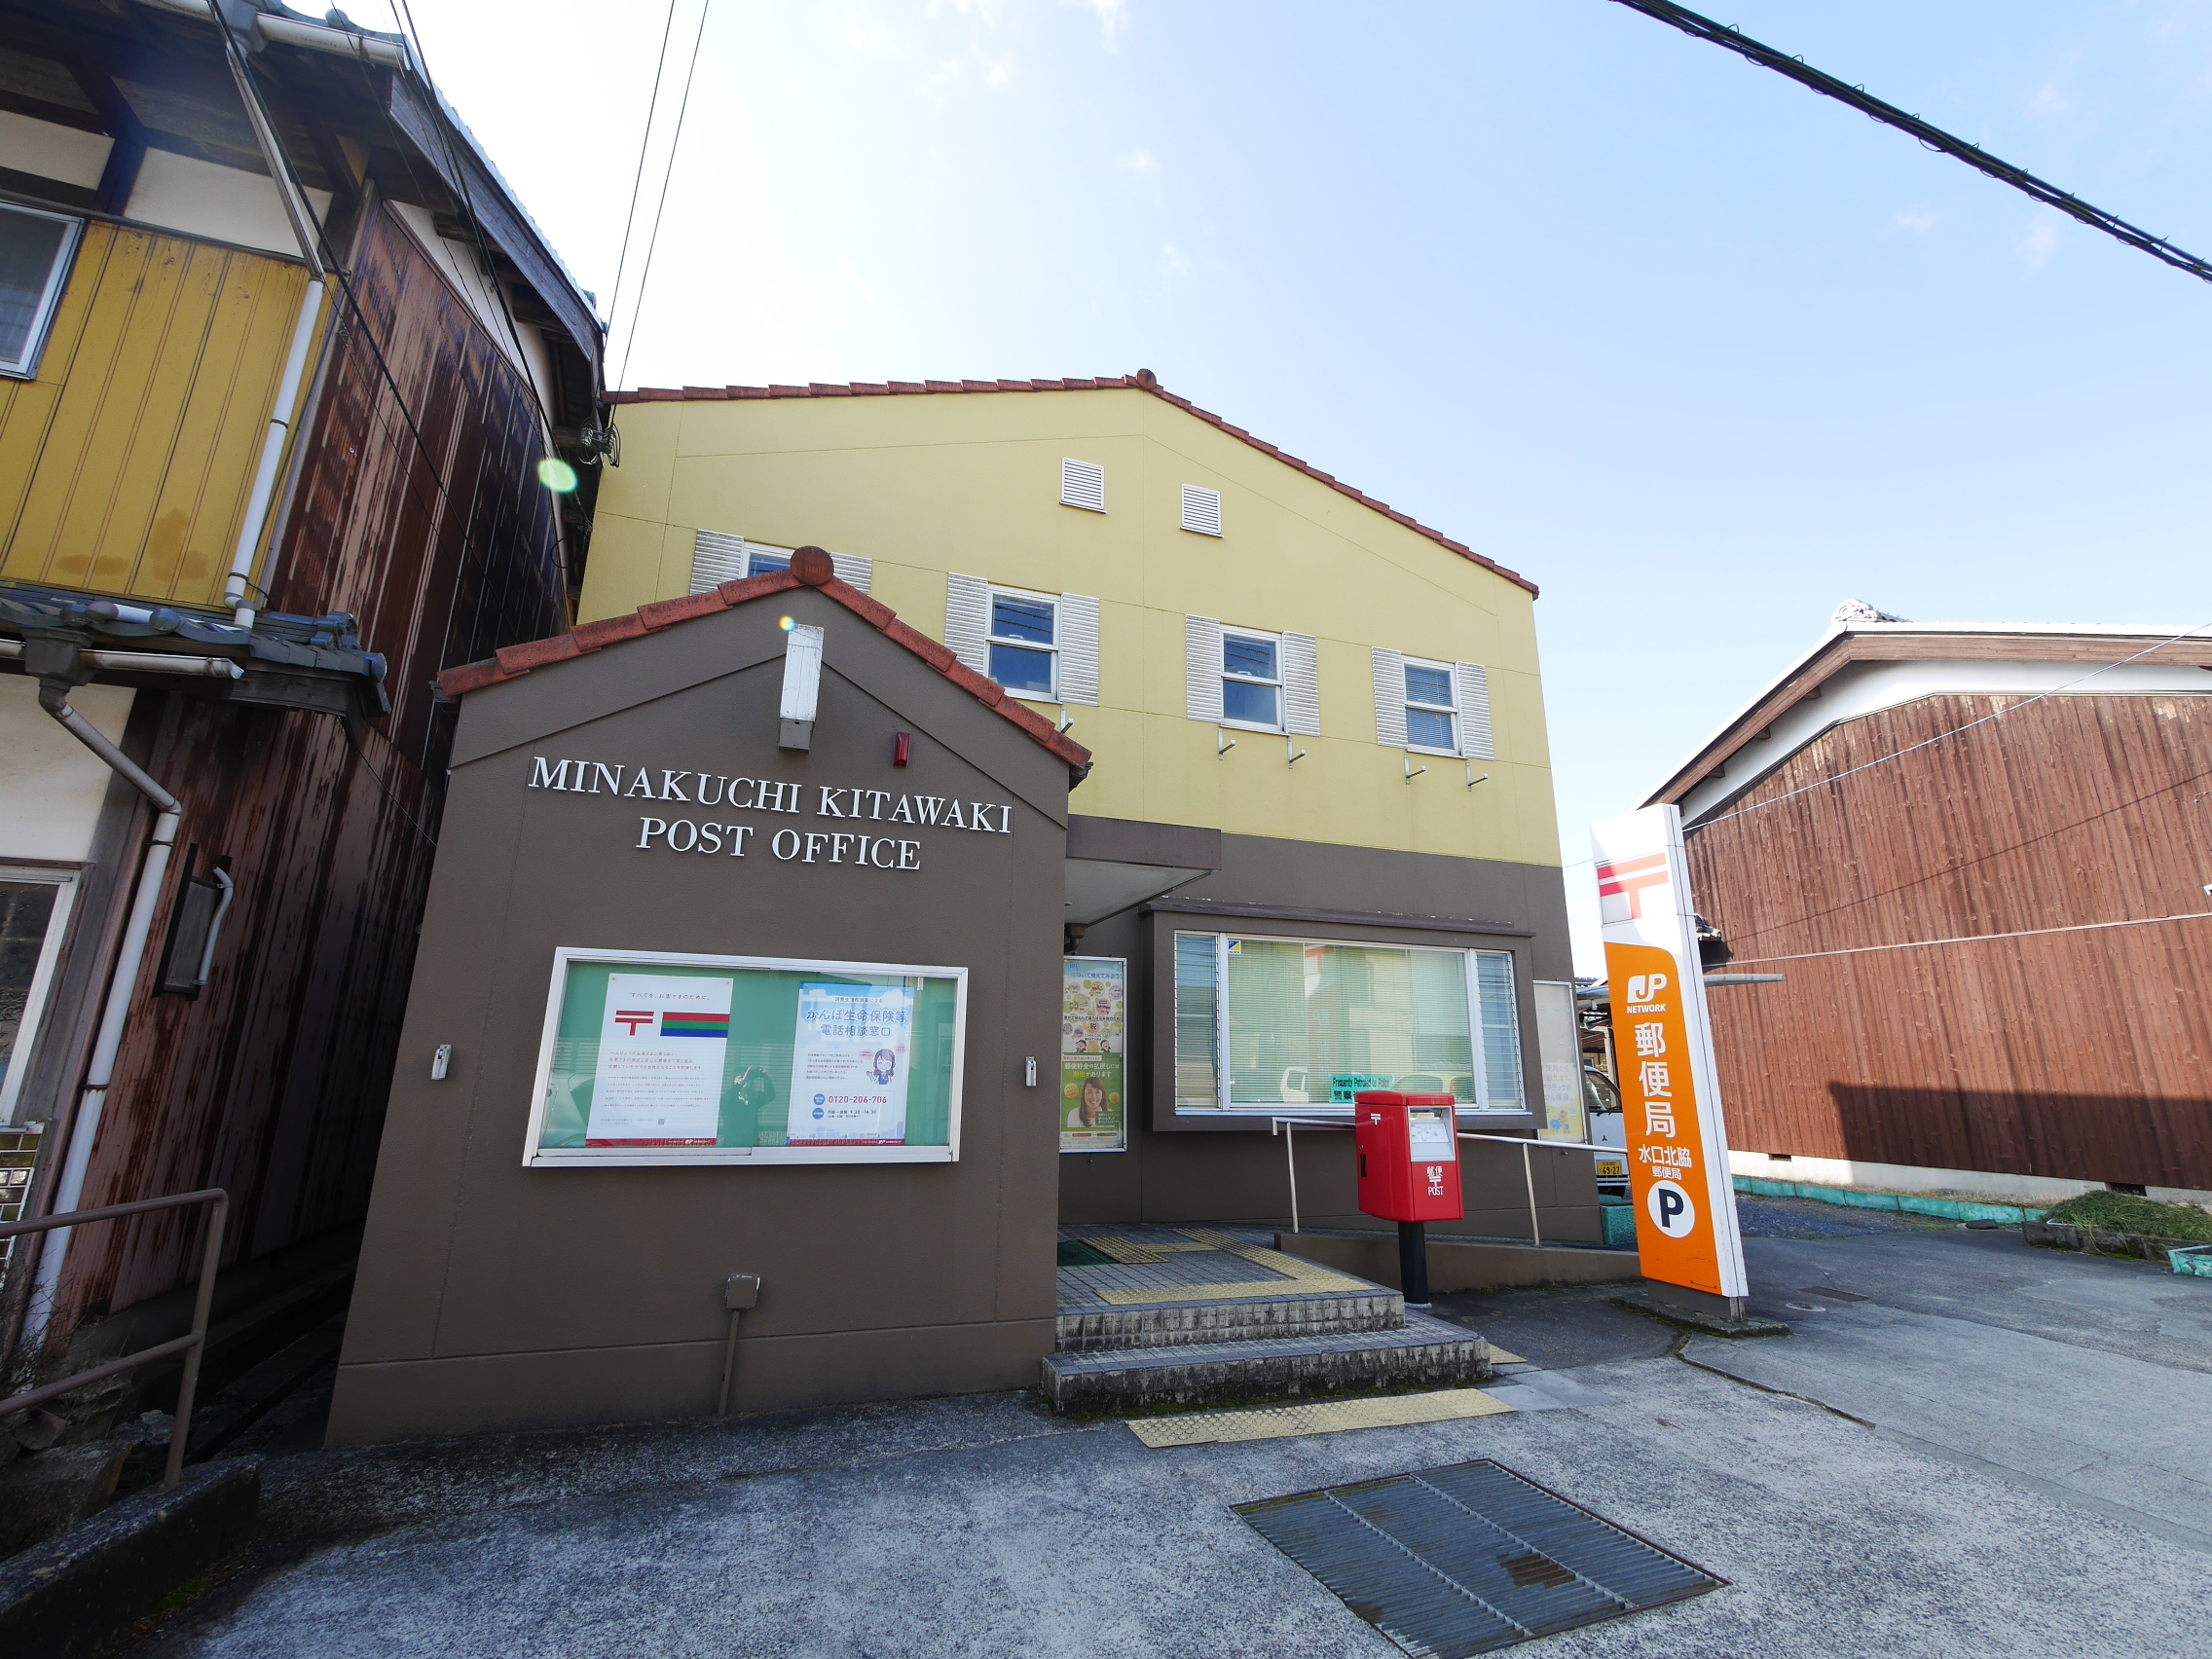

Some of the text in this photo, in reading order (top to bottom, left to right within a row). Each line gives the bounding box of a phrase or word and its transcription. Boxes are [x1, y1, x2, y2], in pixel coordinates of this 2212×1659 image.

[529, 756, 1013, 833] MINAKUCHI KITAWAKI
[636, 817, 922, 870] POST OFFICE
[806, 1009, 907, 1023] かんぽ生命保険等
[1627, 1004, 1666, 1014] NETWORK
[821, 1024, 891, 1037] 電話相談窓口
[1333, 1077, 1352, 1088] Frequently
[1635, 1021, 1676, 1138] 郵便局
[829, 1095, 887, 1104] 0120-206-706
[1638, 1144, 1692, 1167] 水口北脇
[1426, 1166, 1443, 1177] 郵便
[1651, 1165, 1682, 1180] 郵便局
[1427, 1186, 1444, 1196] POST
[1658, 1188, 1684, 1228] P
